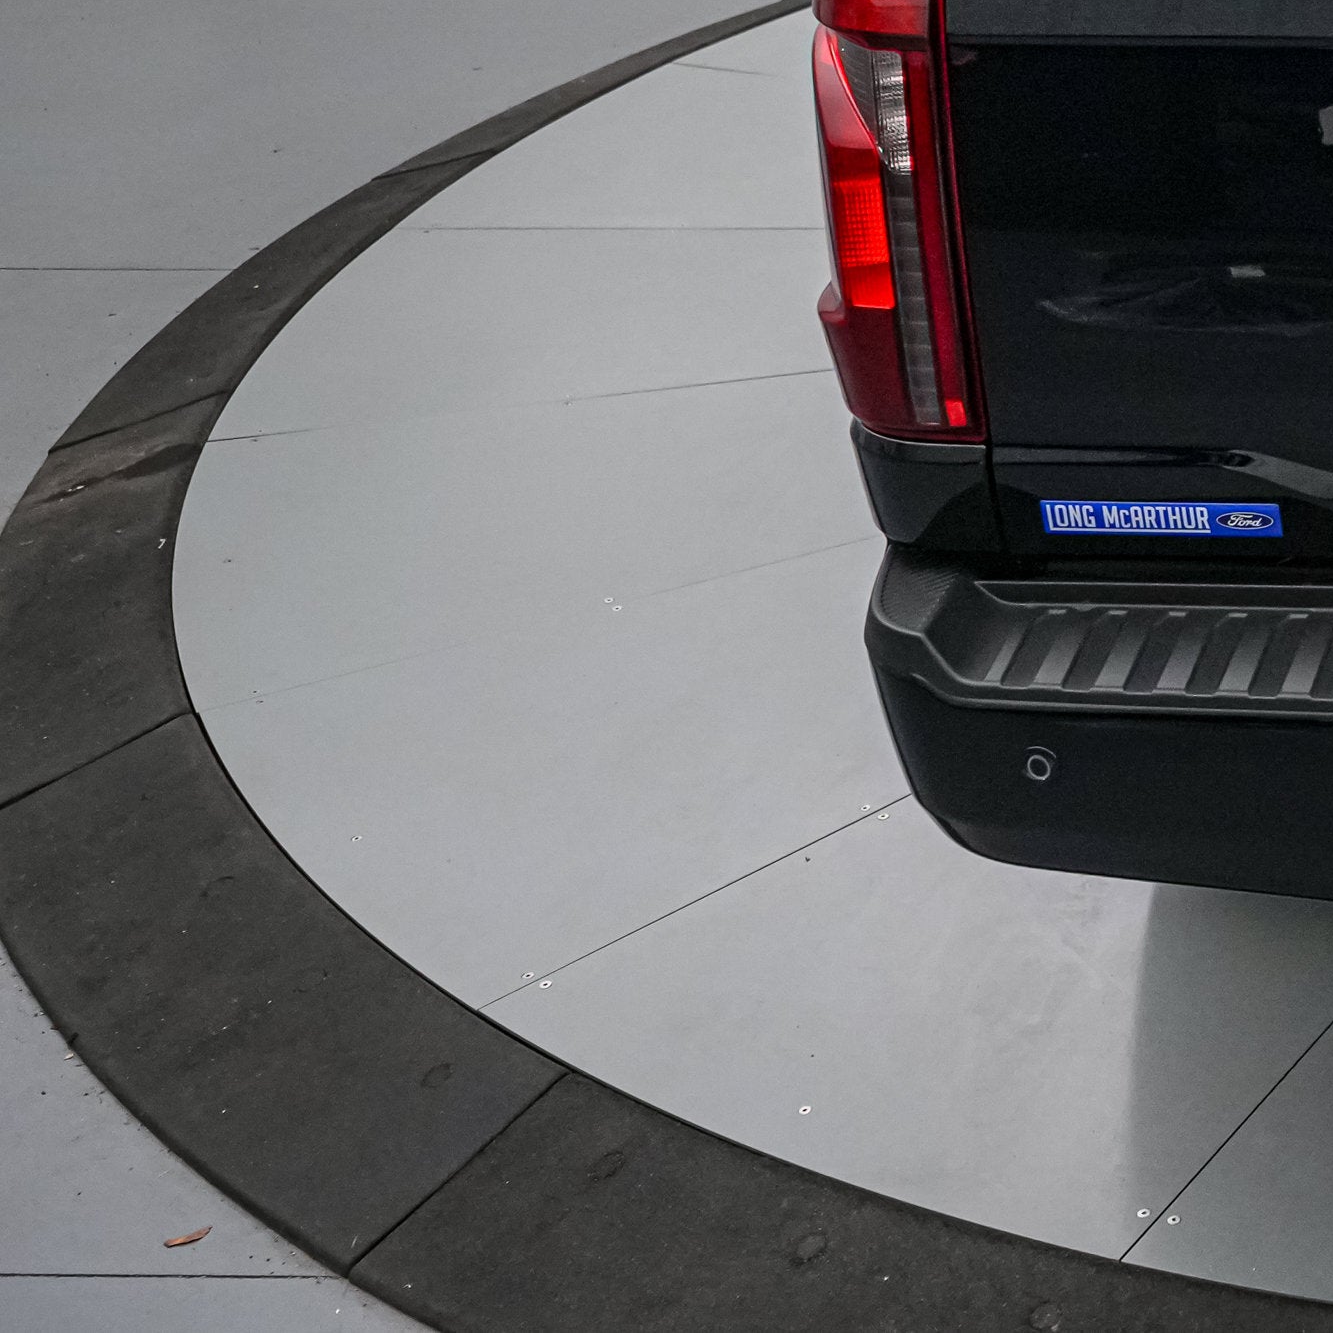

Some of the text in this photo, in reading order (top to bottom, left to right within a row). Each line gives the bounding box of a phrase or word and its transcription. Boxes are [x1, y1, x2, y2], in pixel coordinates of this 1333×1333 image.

[1046, 504, 1210, 532] LONG McARTHUR
[1227, 513, 1261, 528] Ford
